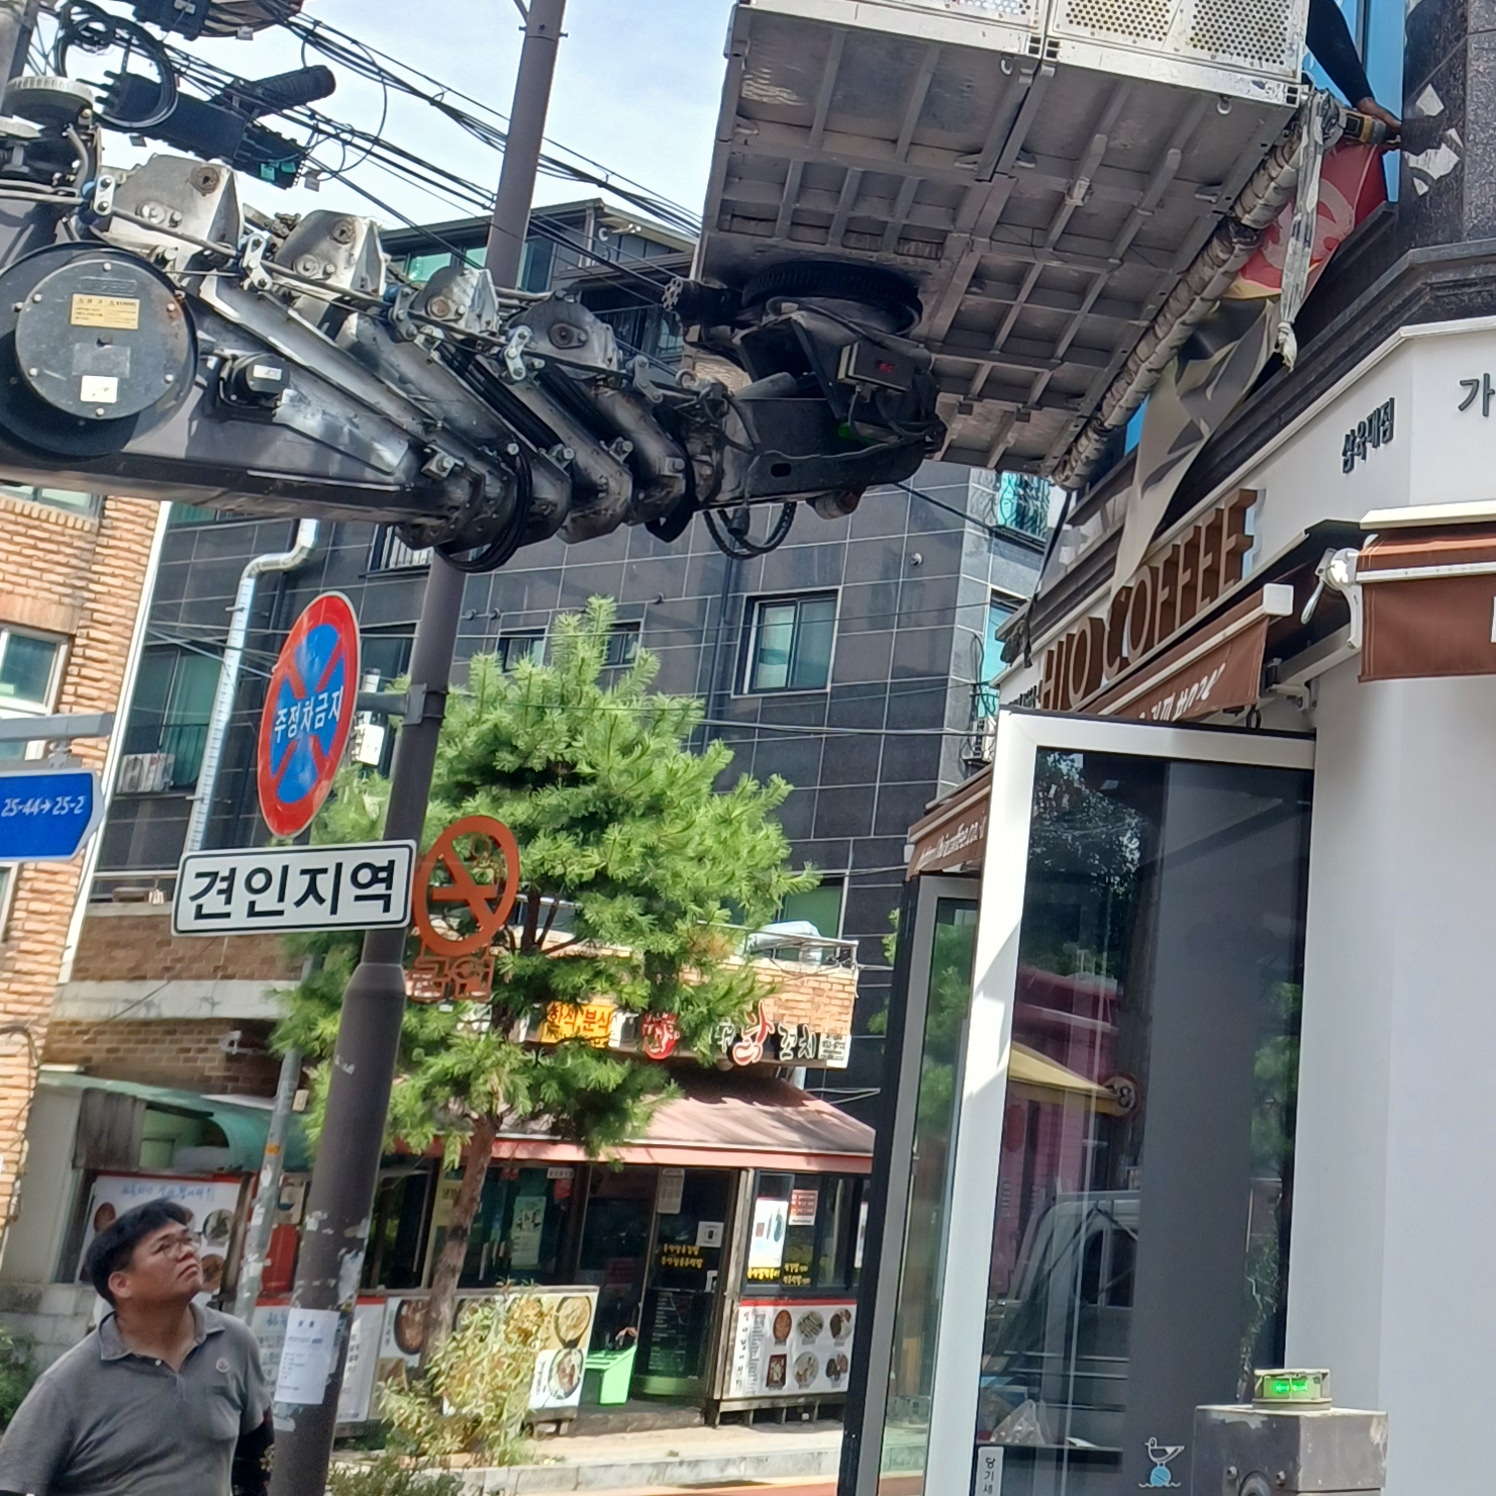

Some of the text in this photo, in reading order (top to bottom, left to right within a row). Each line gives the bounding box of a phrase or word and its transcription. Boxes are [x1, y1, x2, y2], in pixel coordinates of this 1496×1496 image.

[1342, 397, 1395, 474] 삼육대점
[1040, 616, 1106, 711] HIO
[1102, 489, 1257, 681] COFFEE
[274, 685, 344, 744] 주정차금지
[0, 795, 86, 818] 25-44 25-2
[188, 859, 396, 920] 견인지역
[582, 1008, 612, 1034] 분식
